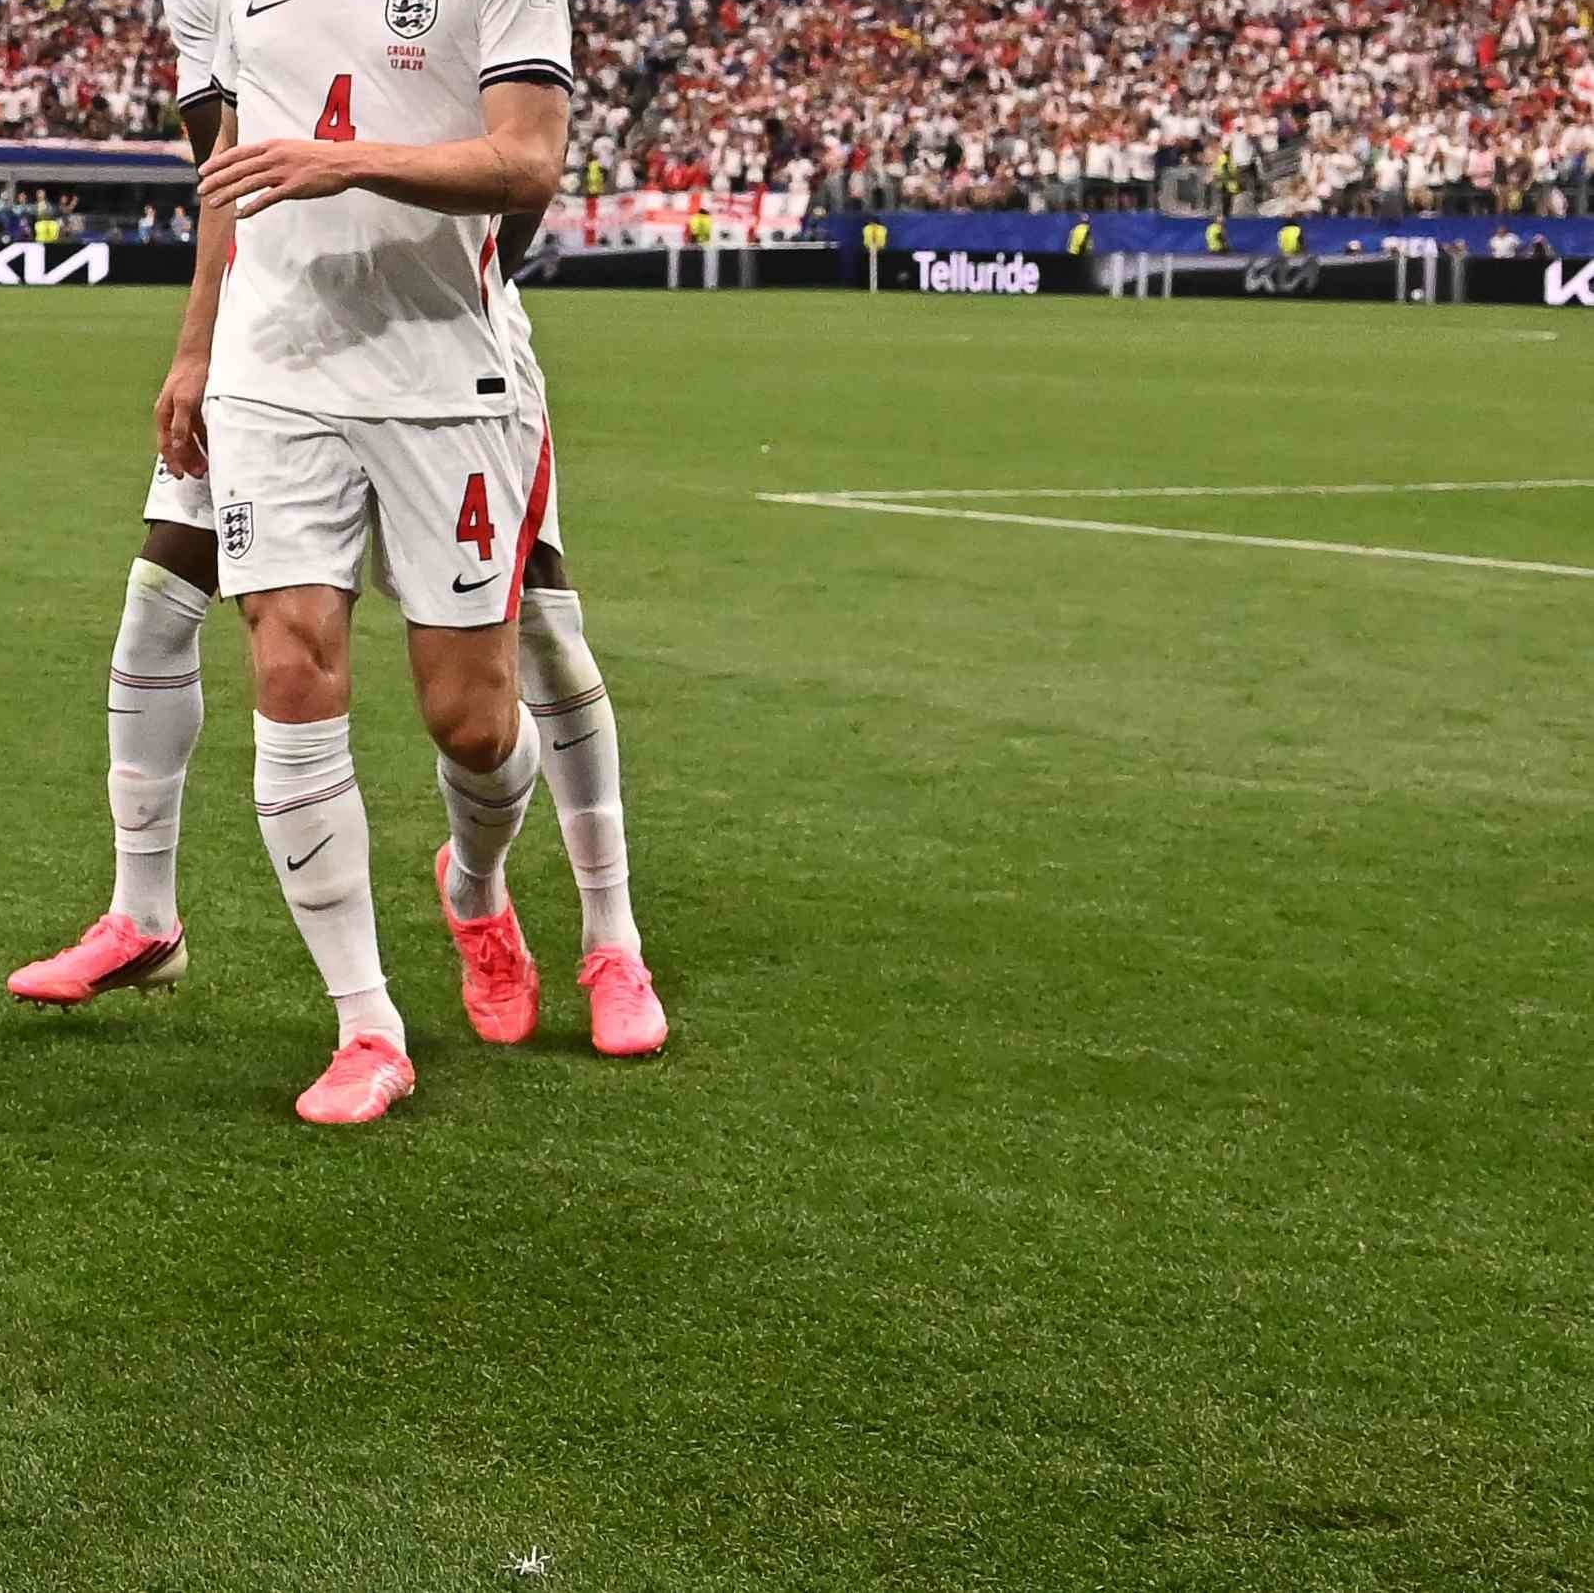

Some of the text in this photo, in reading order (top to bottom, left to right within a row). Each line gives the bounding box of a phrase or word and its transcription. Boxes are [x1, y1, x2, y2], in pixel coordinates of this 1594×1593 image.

[386, 45, 427, 57] CROATIA
[314, 74, 356, 142] 4
[912, 251, 1041, 294] Telluride
[456, 473, 494, 561] 4
